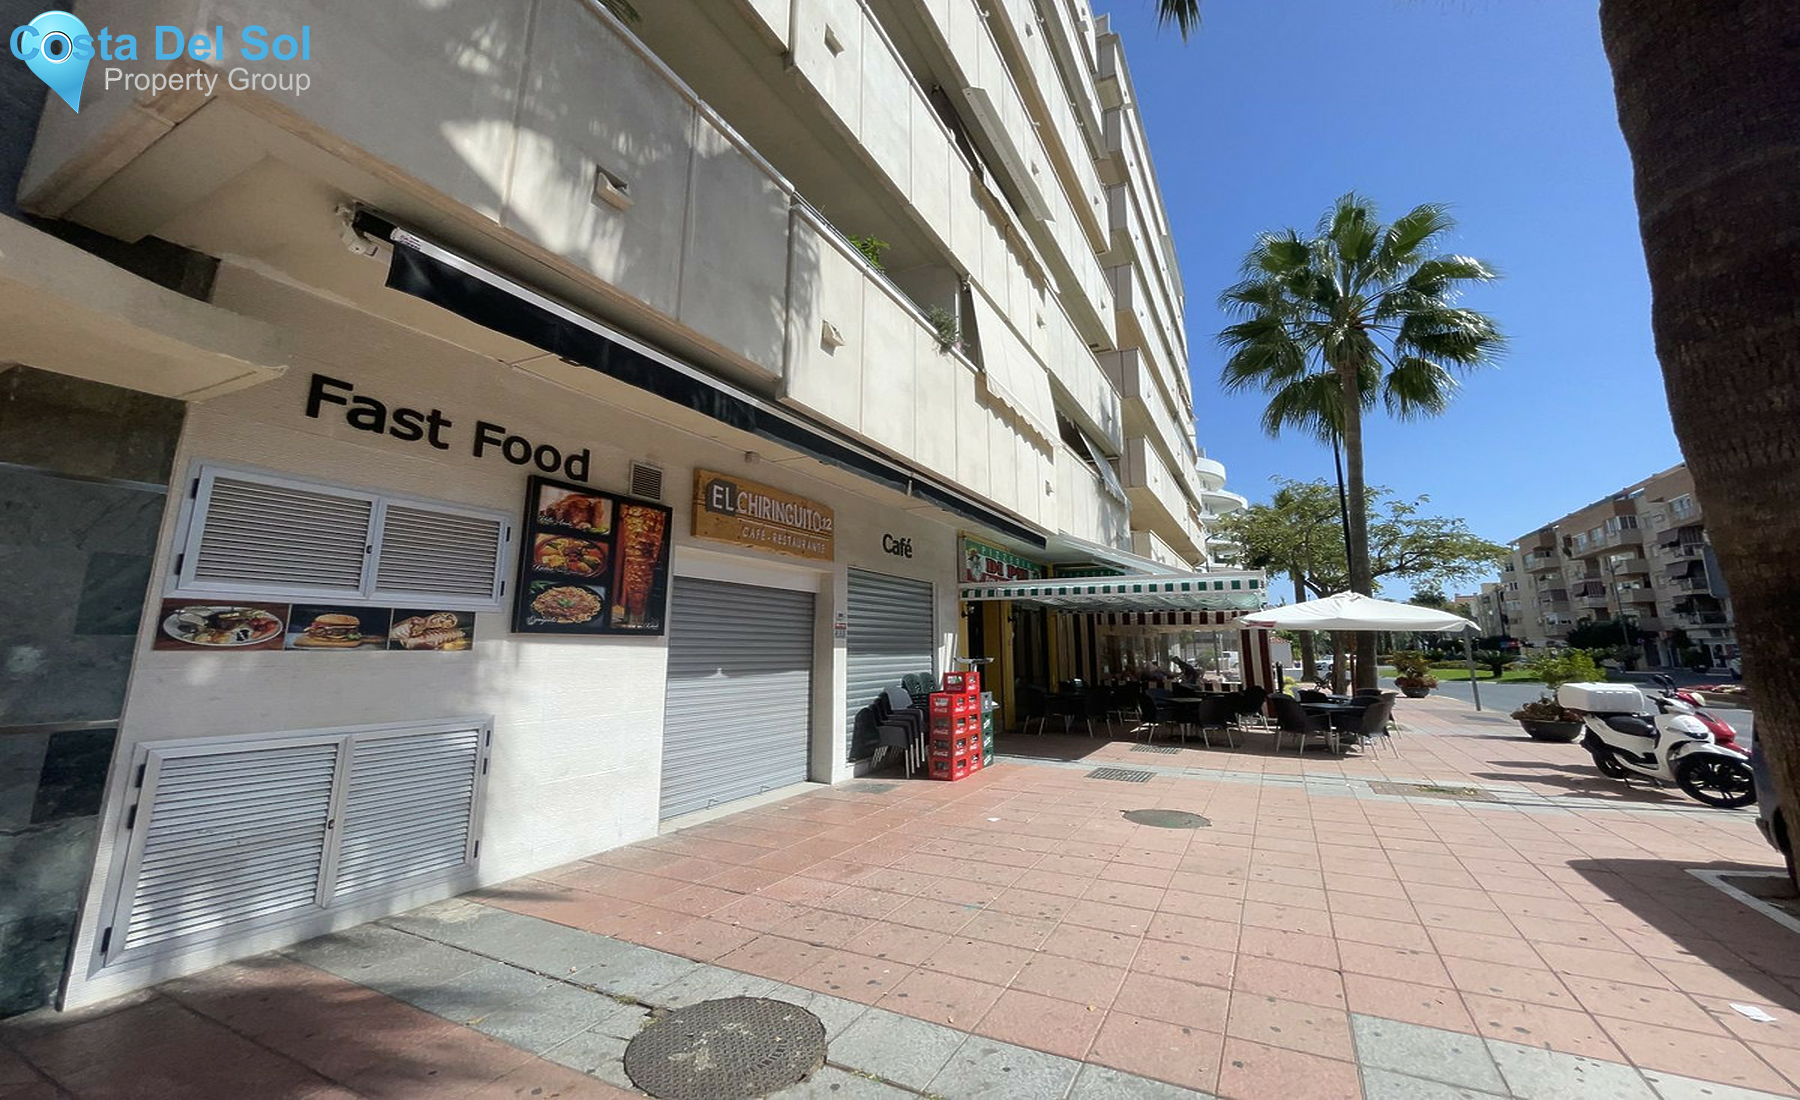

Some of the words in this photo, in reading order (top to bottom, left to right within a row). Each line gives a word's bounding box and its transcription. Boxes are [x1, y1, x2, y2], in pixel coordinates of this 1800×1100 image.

[305, 373, 452, 450] Fast
[472, 420, 590, 482] Food
[712, 485, 735, 512] EL
[737, 491, 821, 532] CHIRINGUITO
[773, 532, 826, 554] RESTAURANTE
[882, 533, 913, 559] Café
